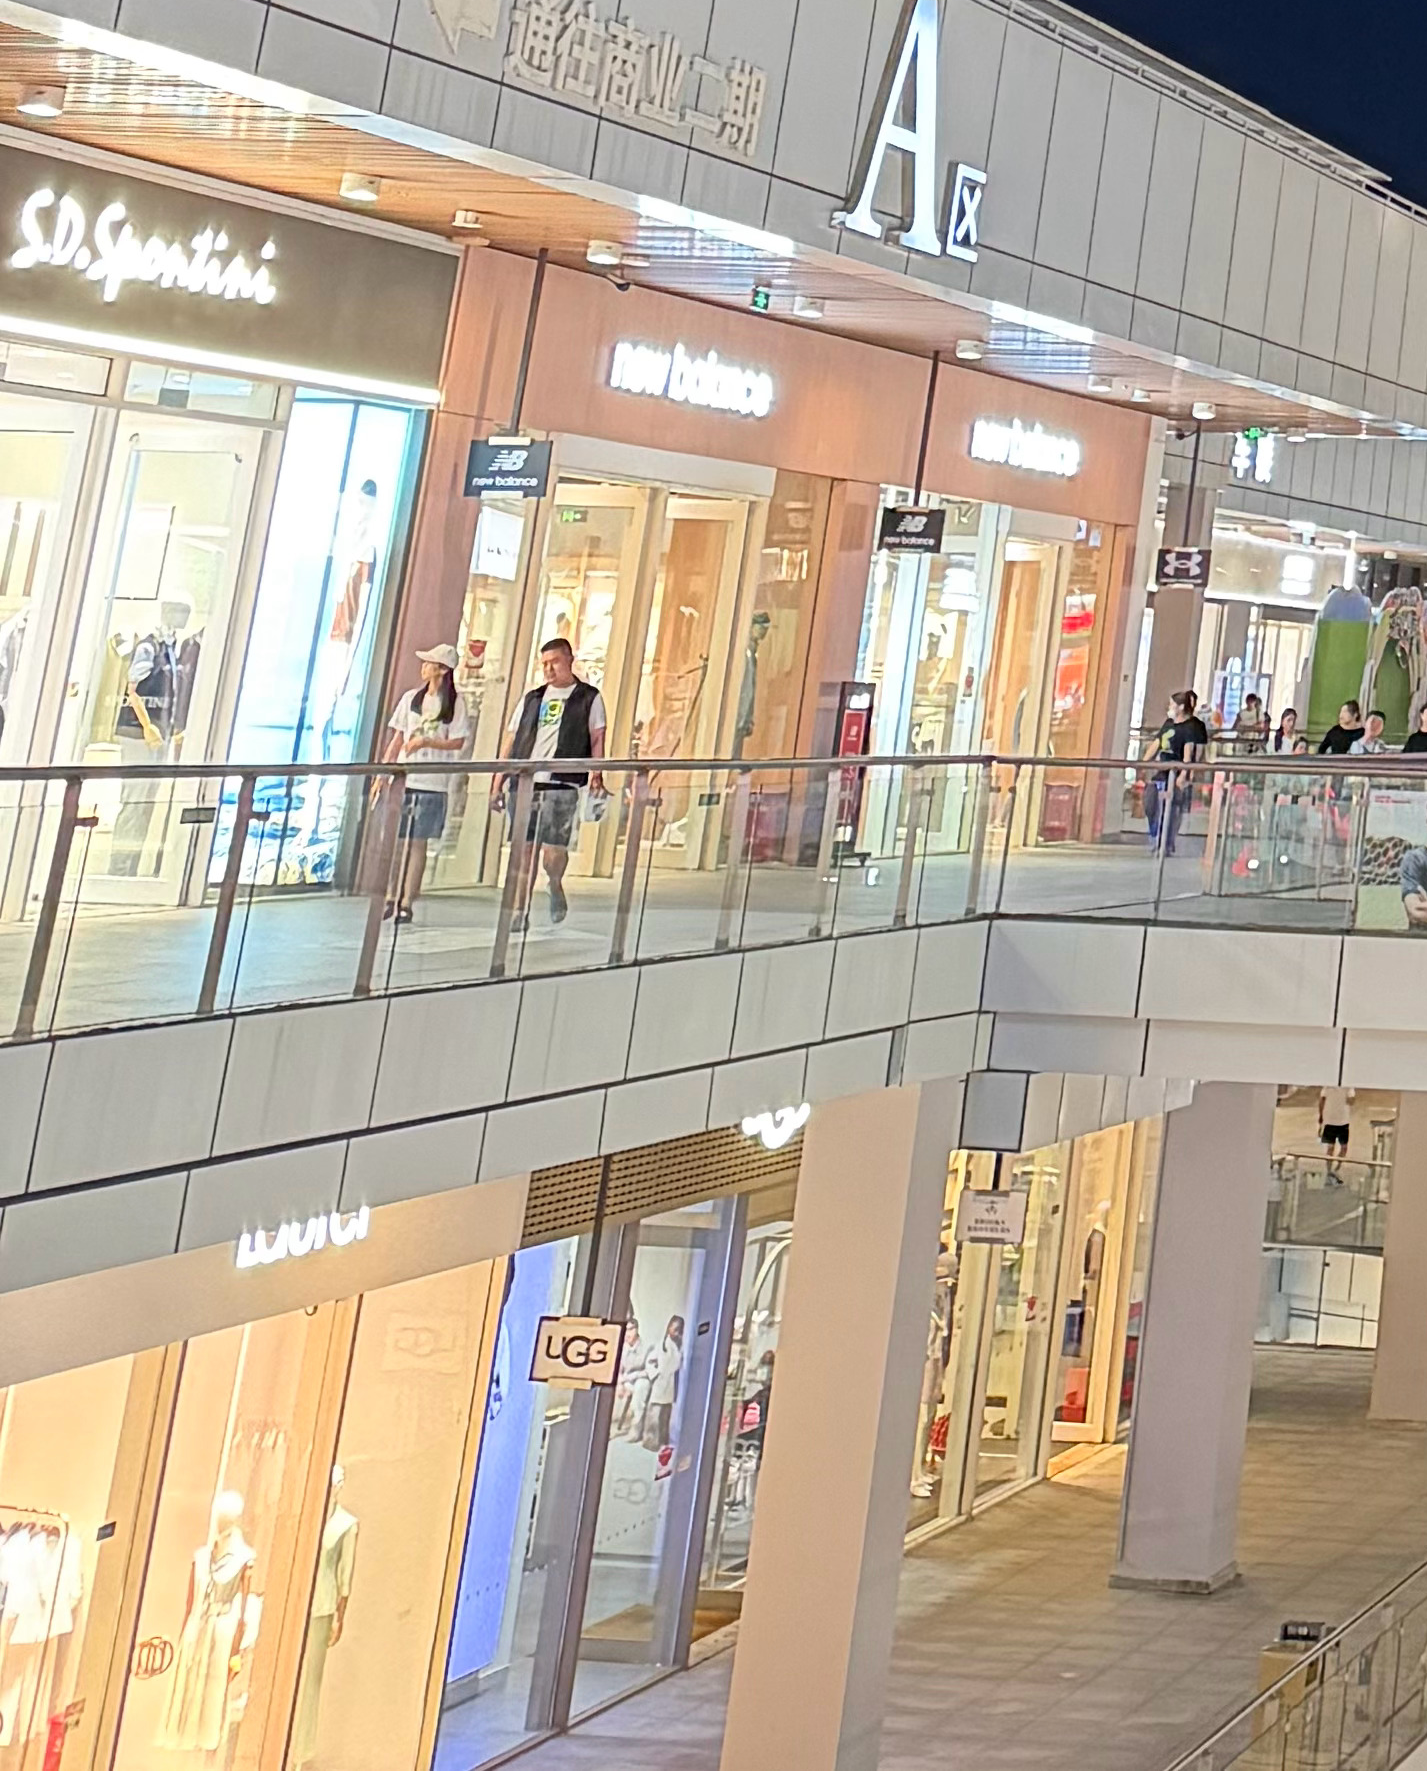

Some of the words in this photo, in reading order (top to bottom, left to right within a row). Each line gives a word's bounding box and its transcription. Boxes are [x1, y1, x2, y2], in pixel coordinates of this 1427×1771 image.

[472, 475, 495, 487] new
[495, 475, 539, 488] balance
[544, 1334, 609, 1369] UGG
